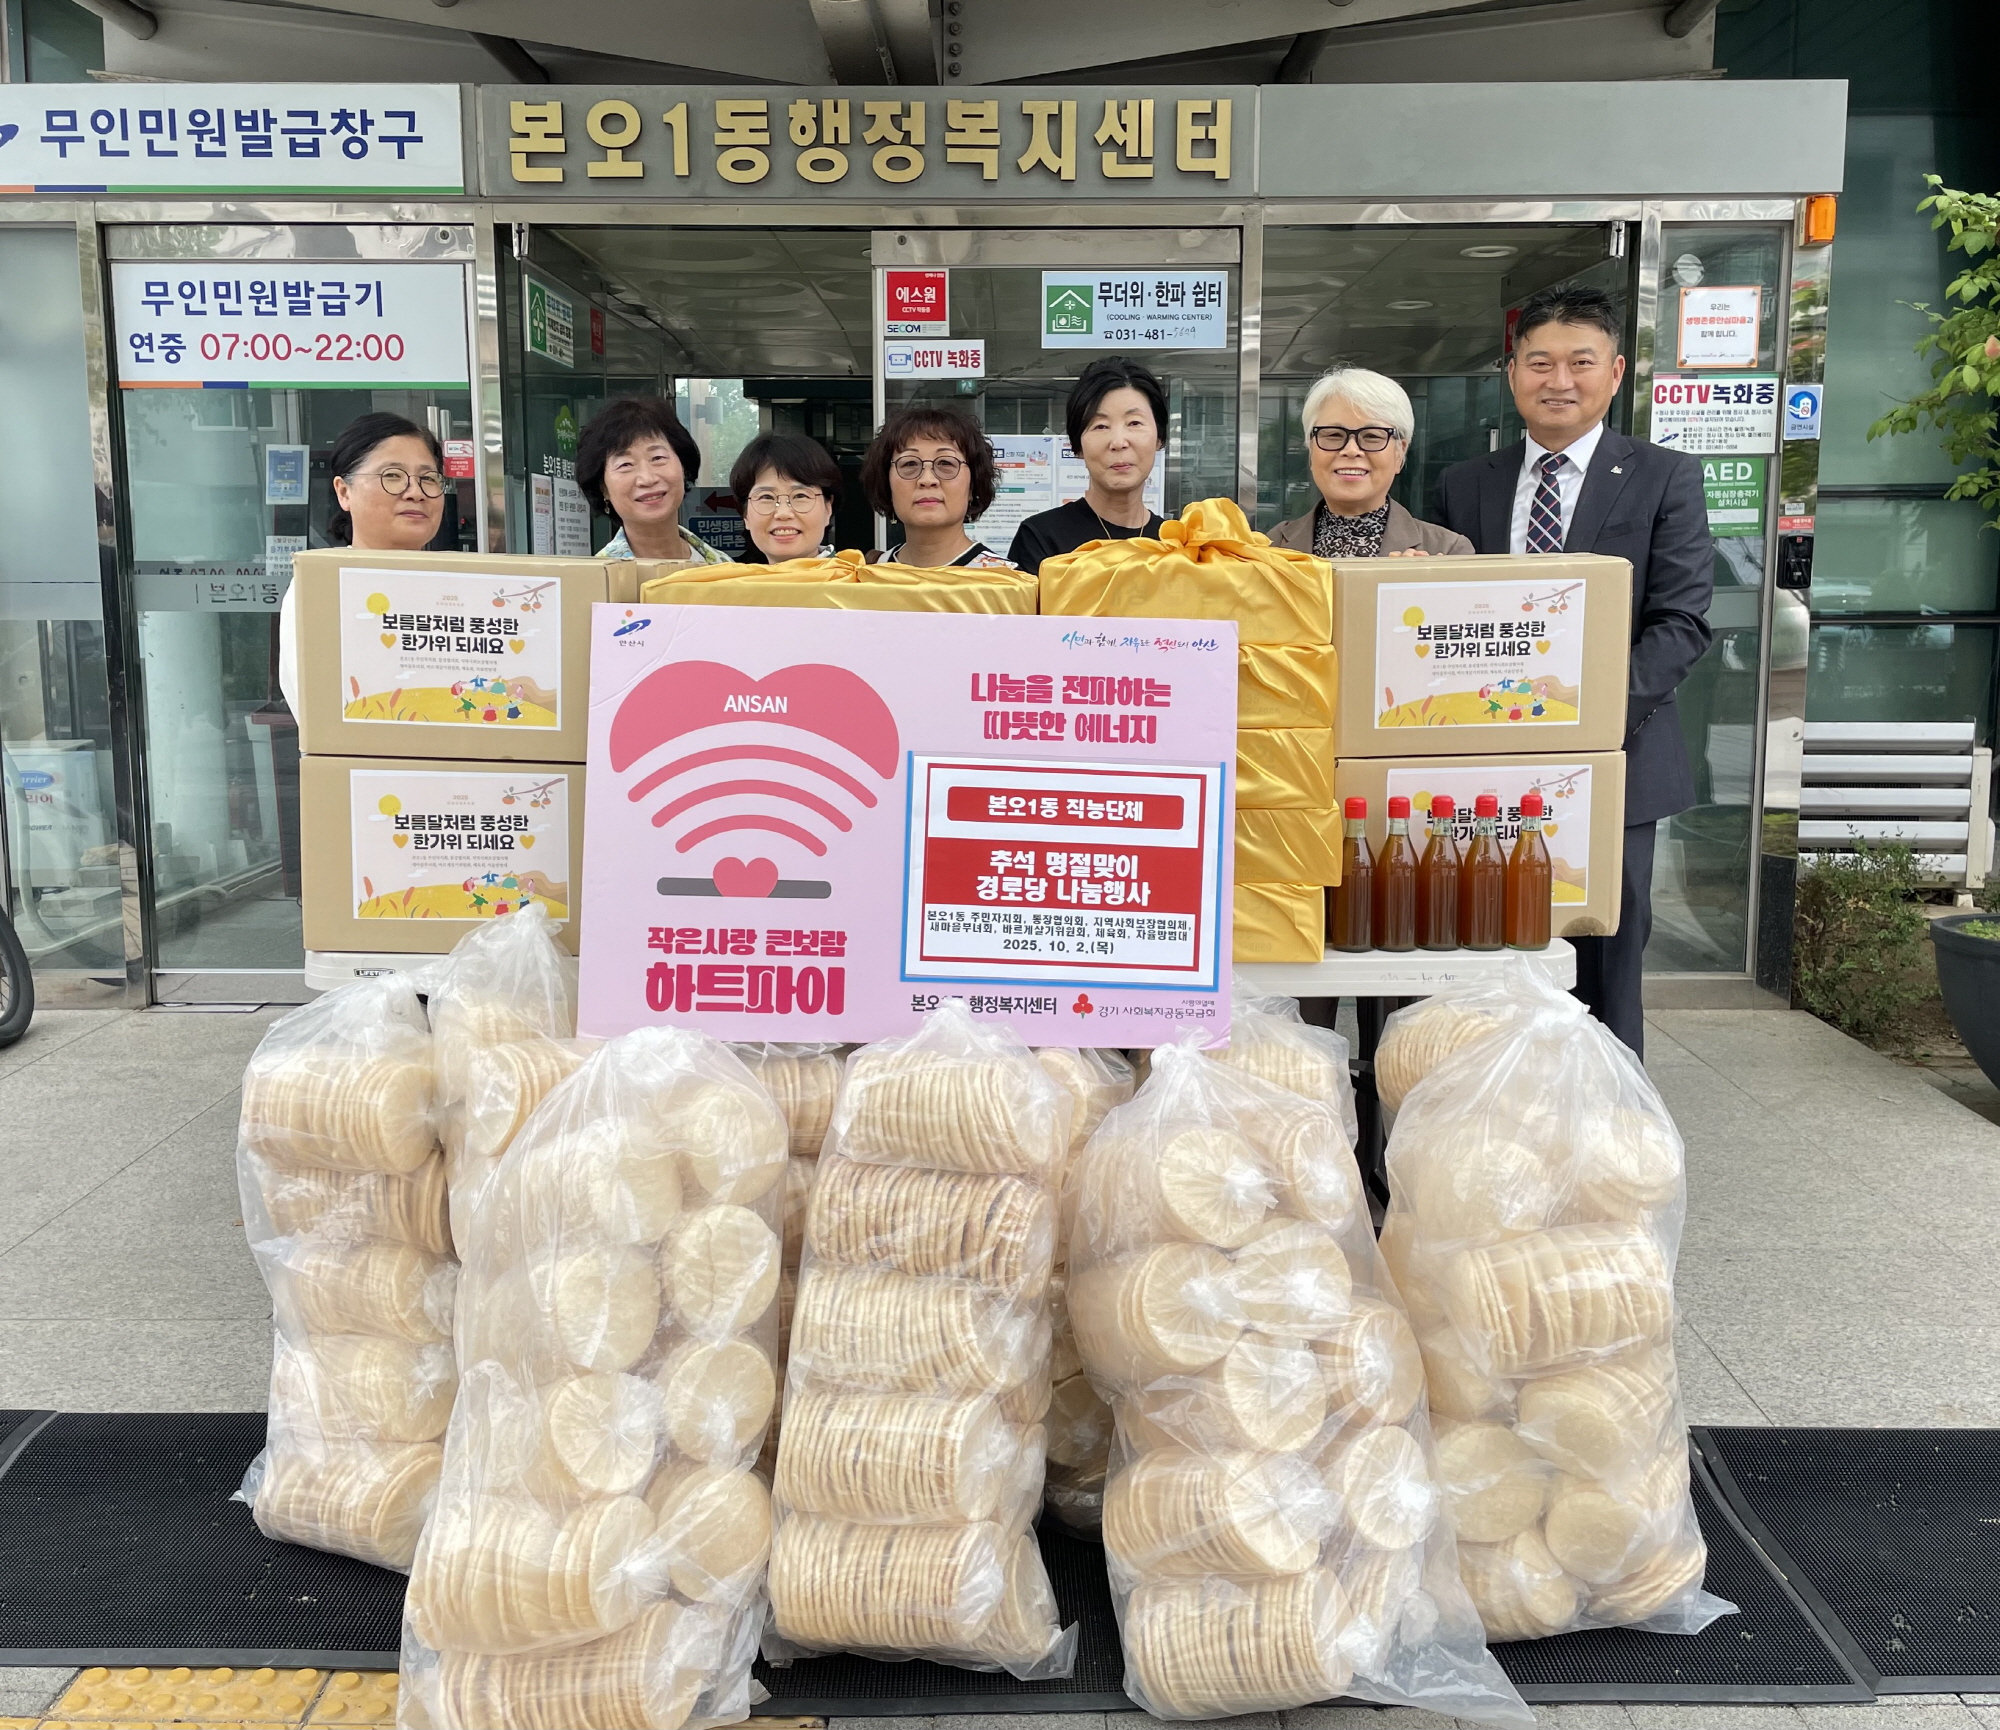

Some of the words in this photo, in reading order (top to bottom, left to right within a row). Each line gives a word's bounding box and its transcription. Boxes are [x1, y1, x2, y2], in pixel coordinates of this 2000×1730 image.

[40, 108, 424, 160] 무인민원발급창구
[140, 280, 384, 317] 무인민원발급기
[895, 286, 936, 303] 에스원
[1192, 281, 1222, 308] 쉼터
[1146, 313, 1180, 321] WARMING
[1181, 313, 1213, 321] CENTER)
[887, 324, 921, 333] SECOM
[129, 332, 187, 365] 연중
[200, 333, 405, 362] 07:00~22:00
[914, 350, 943, 368] CCTV
[947, 349, 981, 368] 녹화중
[1703, 462, 1753, 481] AED
[1706, 489, 1759, 498] 자동심장충격기
[1717, 498, 1749, 507] 설치시설
[209, 583, 279, 604] 본오1동
[382, 612, 465, 633] 보름달처럼
[469, 617, 519, 636] 풍성한
[1417, 622, 1495, 641] 보름달처럼
[1499, 620, 1546, 639] 풍성한
[401, 633, 451, 652] 한가위
[455, 636, 504, 655] 되세요
[618, 639, 645, 647] 안산시
[1191, 638, 1220, 652] 안산
[1434, 642, 1481, 659] 한가위
[1484, 640, 1531, 658] 되세요
[970, 672, 1054, 704] 나눔을
[1062, 675, 1172, 707] 전파하는
[723, 694, 788, 714] ANSAN
[983, 710, 1067, 741] 따뜻한
[1074, 713, 1157, 744] 에너지
[987, 794, 1059, 817] 본오1동
[1065, 797, 1143, 823] 직능단체
[394, 814, 476, 831] 보름달처럼
[480, 814, 529, 832] 풍성한
[413, 833, 462, 851] 한가위
[466, 833, 515, 850] 되세요
[989, 849, 1035, 875] 추석
[1046, 851, 1138, 880] 명절맞이
[975, 875, 1048, 903] 경로당
[1057, 879, 1151, 907] 나눔행사
[927, 910, 965, 922] 본오1동
[971, 911, 1027, 925] 주민자치회,
[1031, 914, 1088, 926] 통장협의회,
[929, 921, 997, 934] 새마을부녀회,
[1002, 924, 1090, 938] 바르게살기위원회,
[647, 926, 758, 956] 작은사랑
[765, 929, 848, 957] 큰보람
[1003, 939, 1042, 953] 2025.
[1049, 940, 1069, 954] 10.
[645, 961, 845, 1016] 하트파이
[911, 993, 964, 1012] 본오
[969, 995, 1057, 1015] 행정복지센터
[1098, 1005, 1119, 1018] 경기
[1122, 1006, 1216, 1020] 사회복지공동모금회
